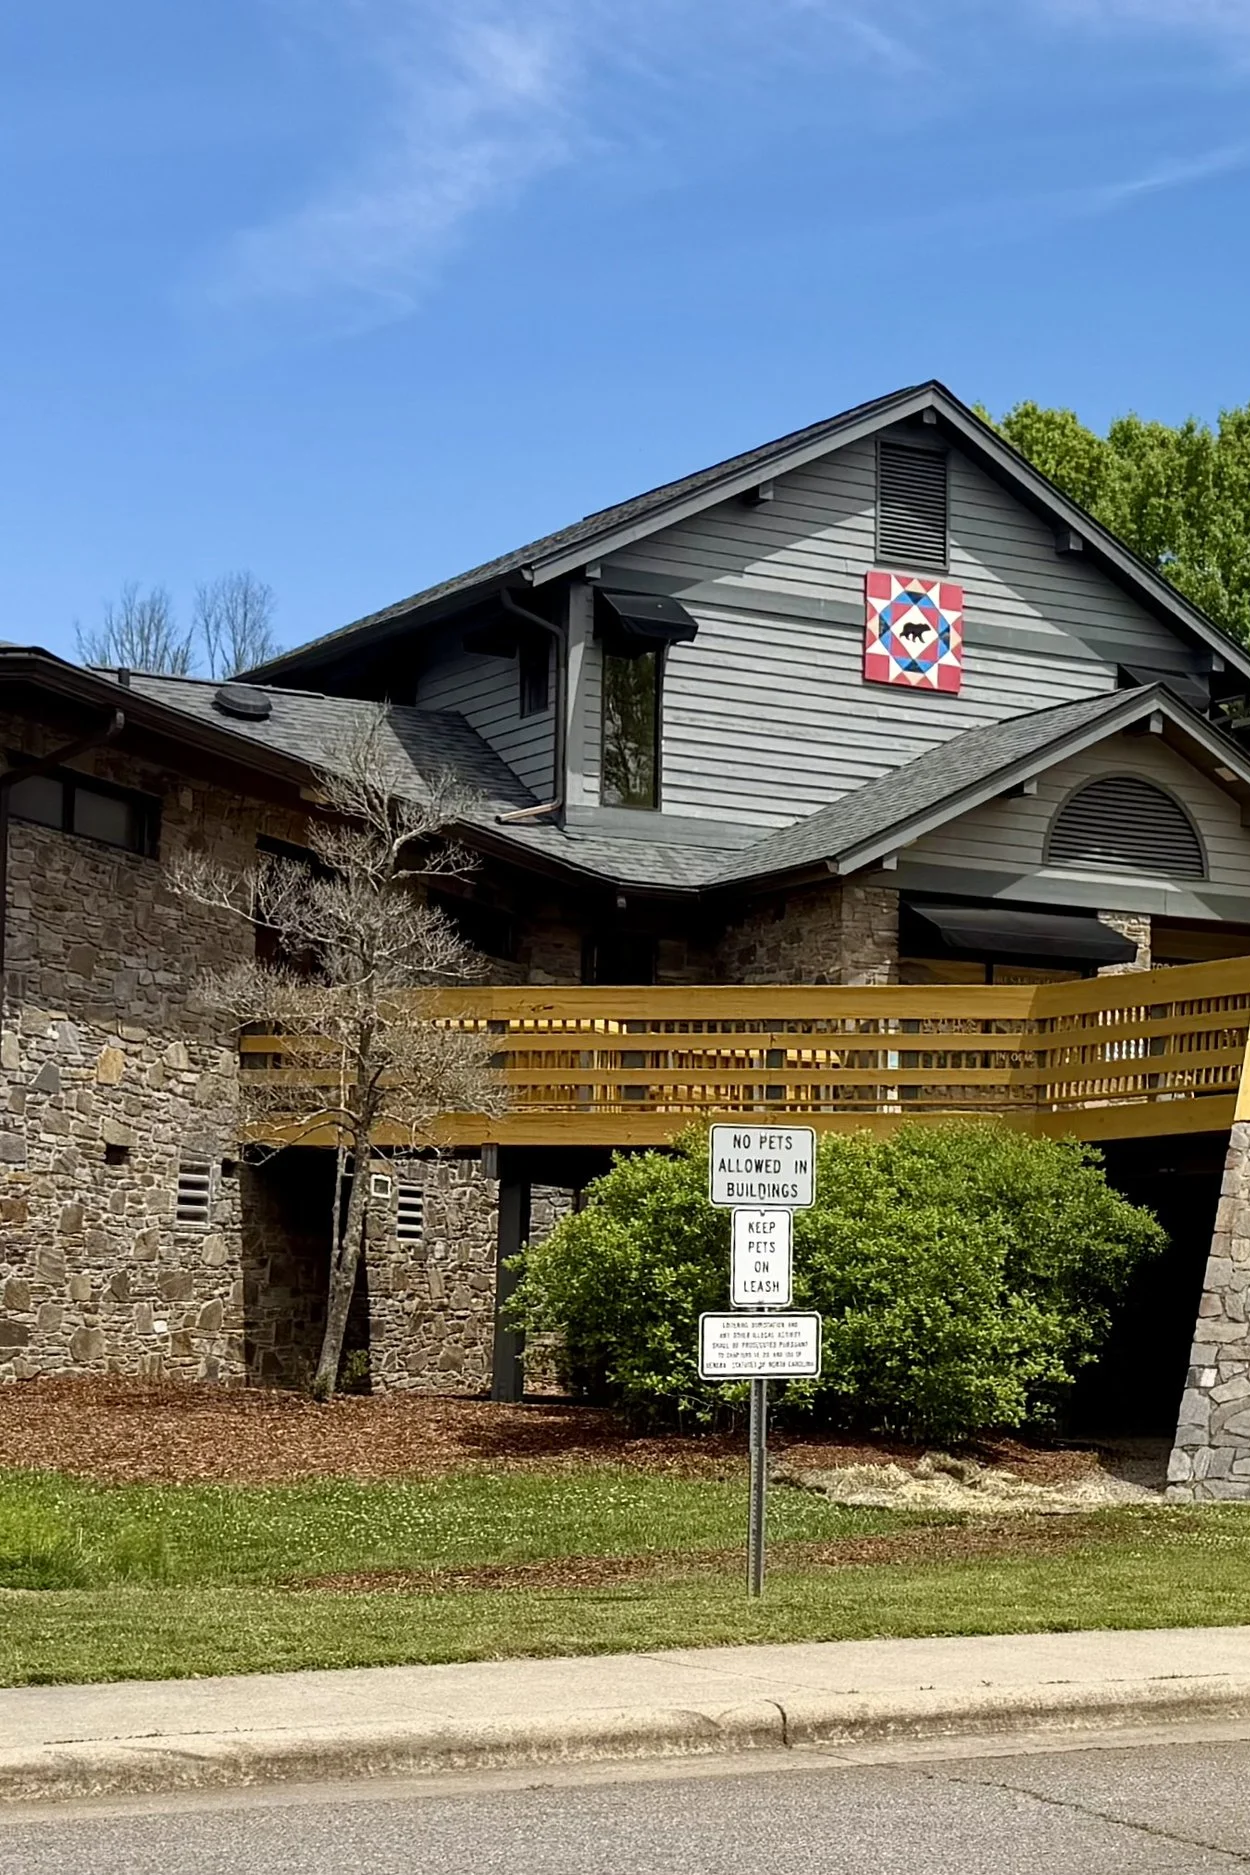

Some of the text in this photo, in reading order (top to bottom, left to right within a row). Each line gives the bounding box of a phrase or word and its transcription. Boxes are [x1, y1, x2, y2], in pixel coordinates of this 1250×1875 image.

[733, 1134, 793, 1150] NO PETS
[718, 1158, 807, 1174] ALLOWED IN
[727, 1182, 798, 1199] BUILDINGS
[748, 1221, 776, 1234] KEEP
[748, 1241, 776, 1254] PETS
[754, 1261, 769, 1273] ON
[743, 1280, 779, 1293] LEASH
